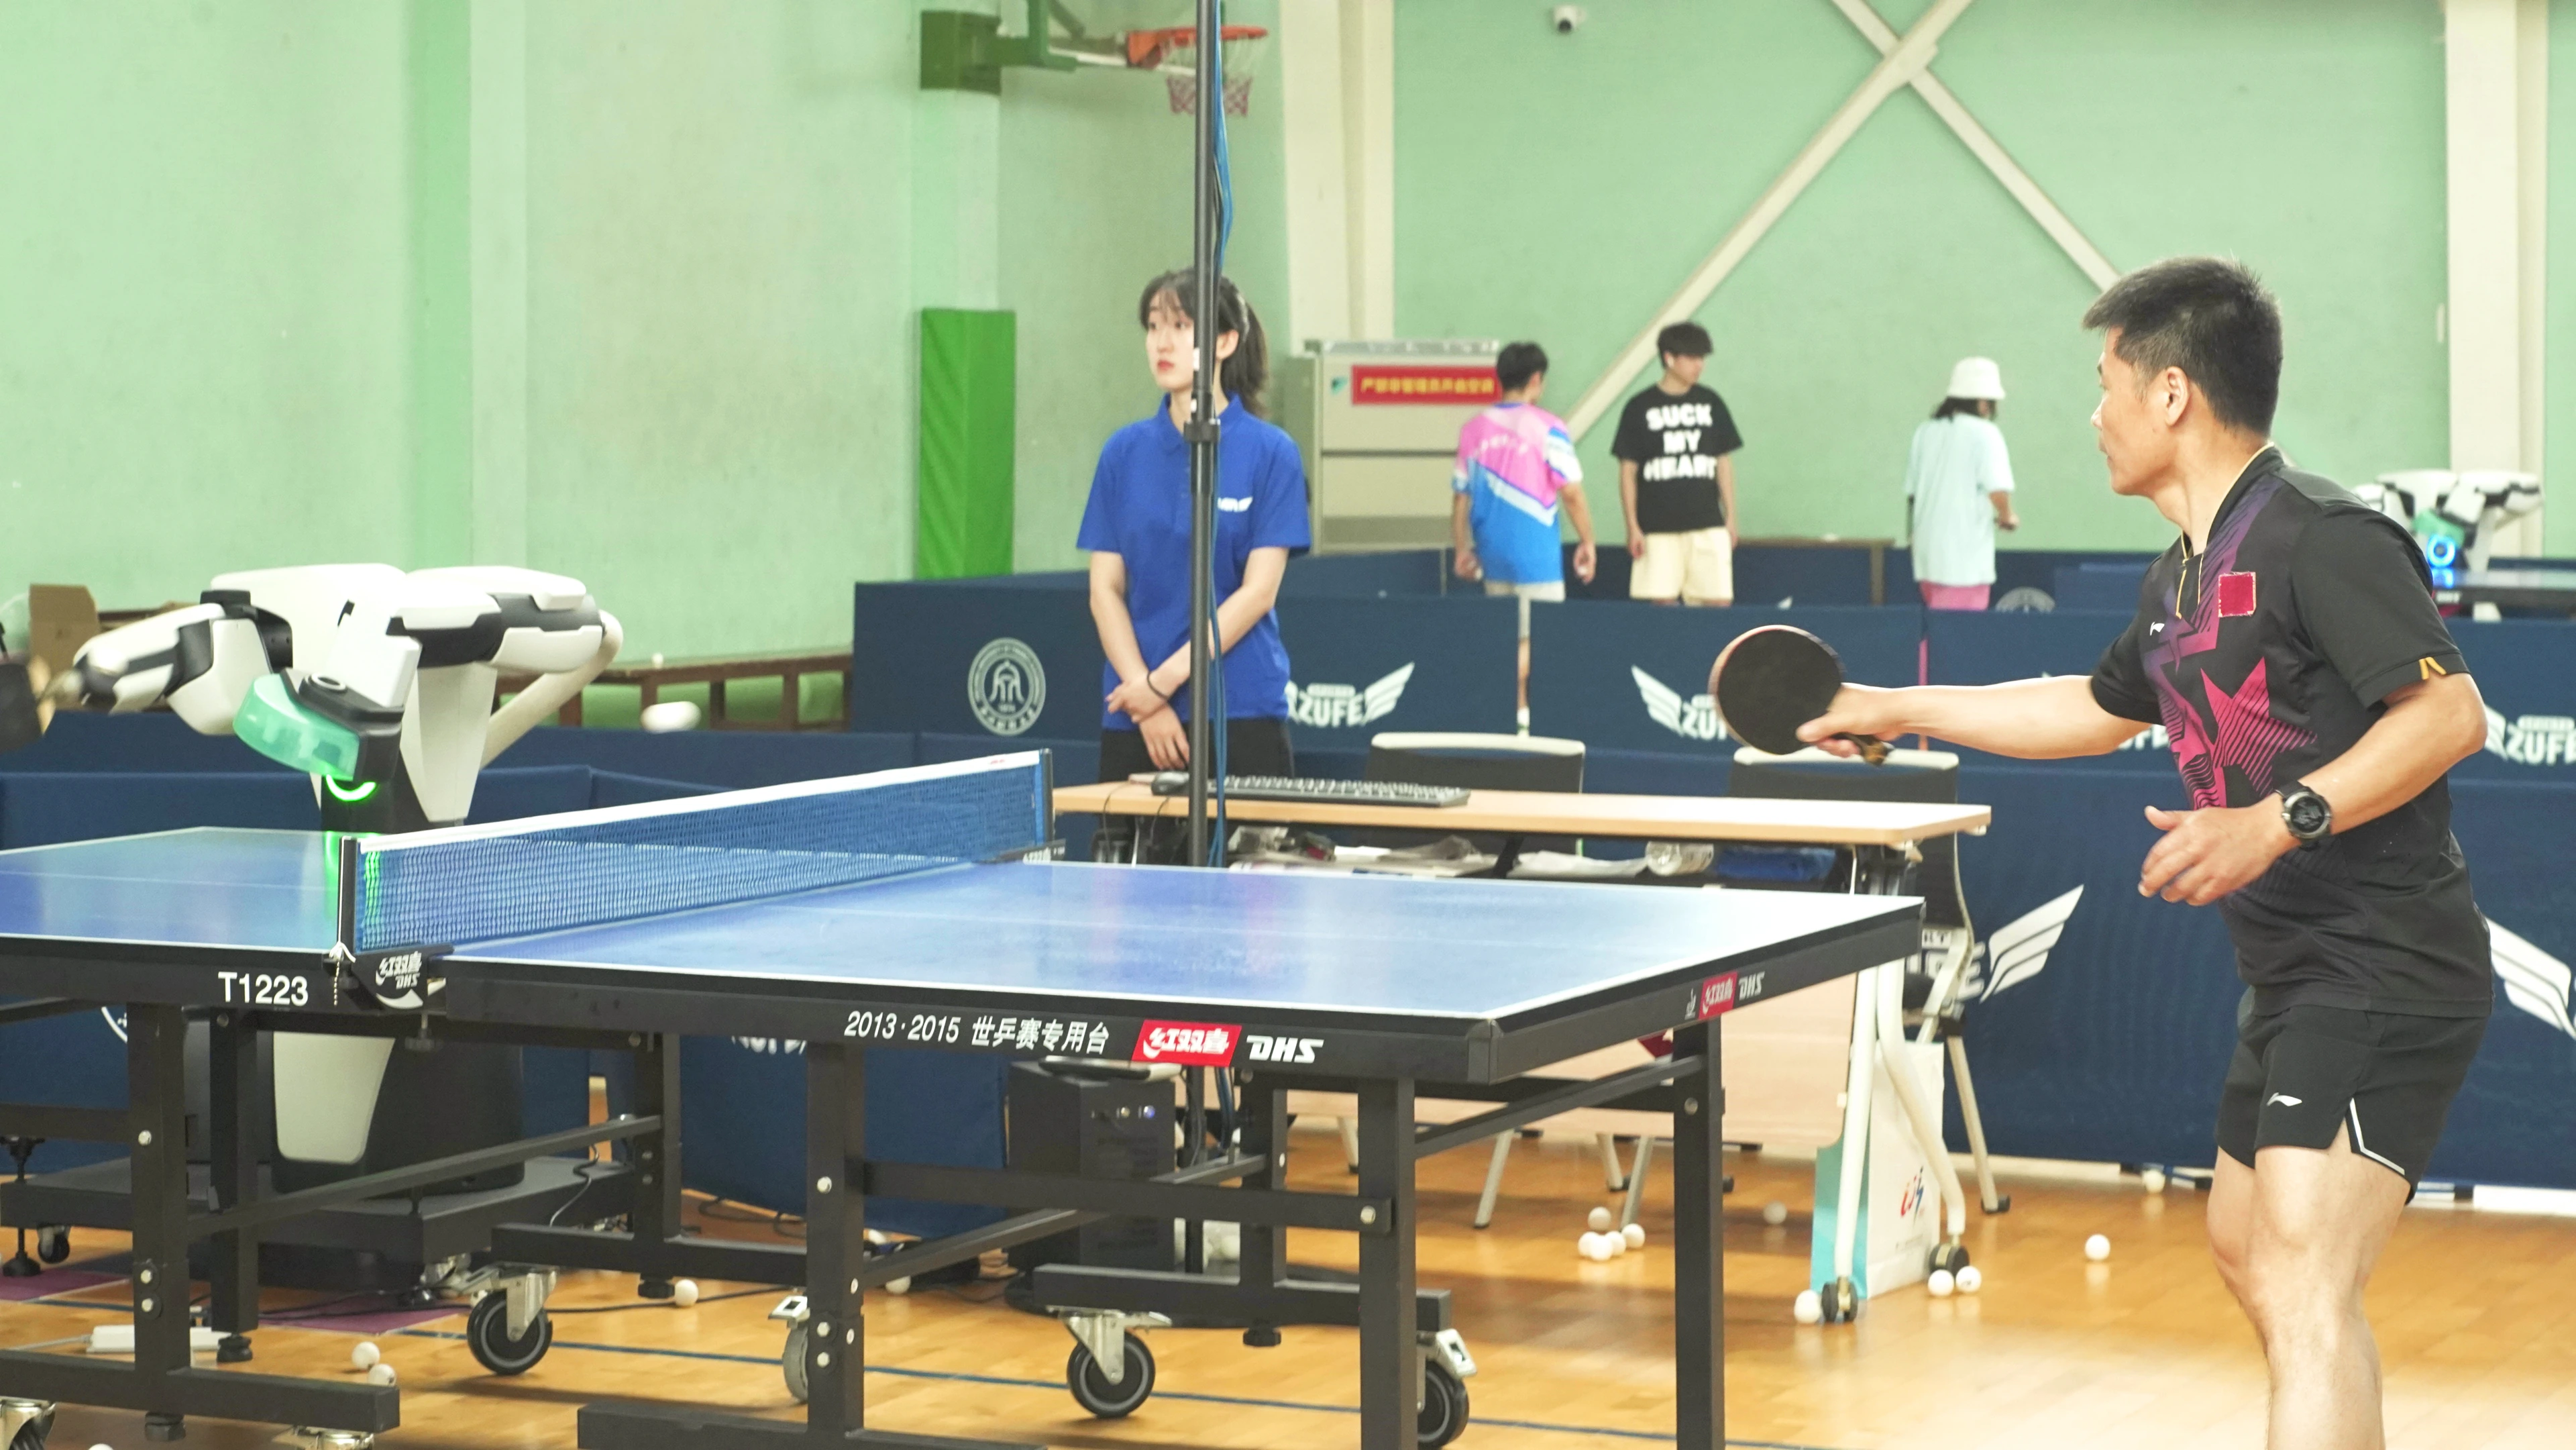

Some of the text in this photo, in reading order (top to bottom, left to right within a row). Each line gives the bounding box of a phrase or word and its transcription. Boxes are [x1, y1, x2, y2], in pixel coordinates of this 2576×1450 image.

[1646, 403, 1713, 431] SUCK
[1663, 429, 1701, 454] MY
[1644, 454, 1717, 481] HEART
[1297, 689, 1364, 727] ZUFE
[1682, 700, 1728, 741] ZU
[218, 972, 309, 1006] T1223
[395, 972, 420, 990] DHS
[1738, 971, 1765, 1000] DHS
[971, 1015, 1109, 1055] 世乒赛专用台
[1143, 1027, 1230, 1059] 红双喜
[1246, 1035, 1324, 1064] DHS
